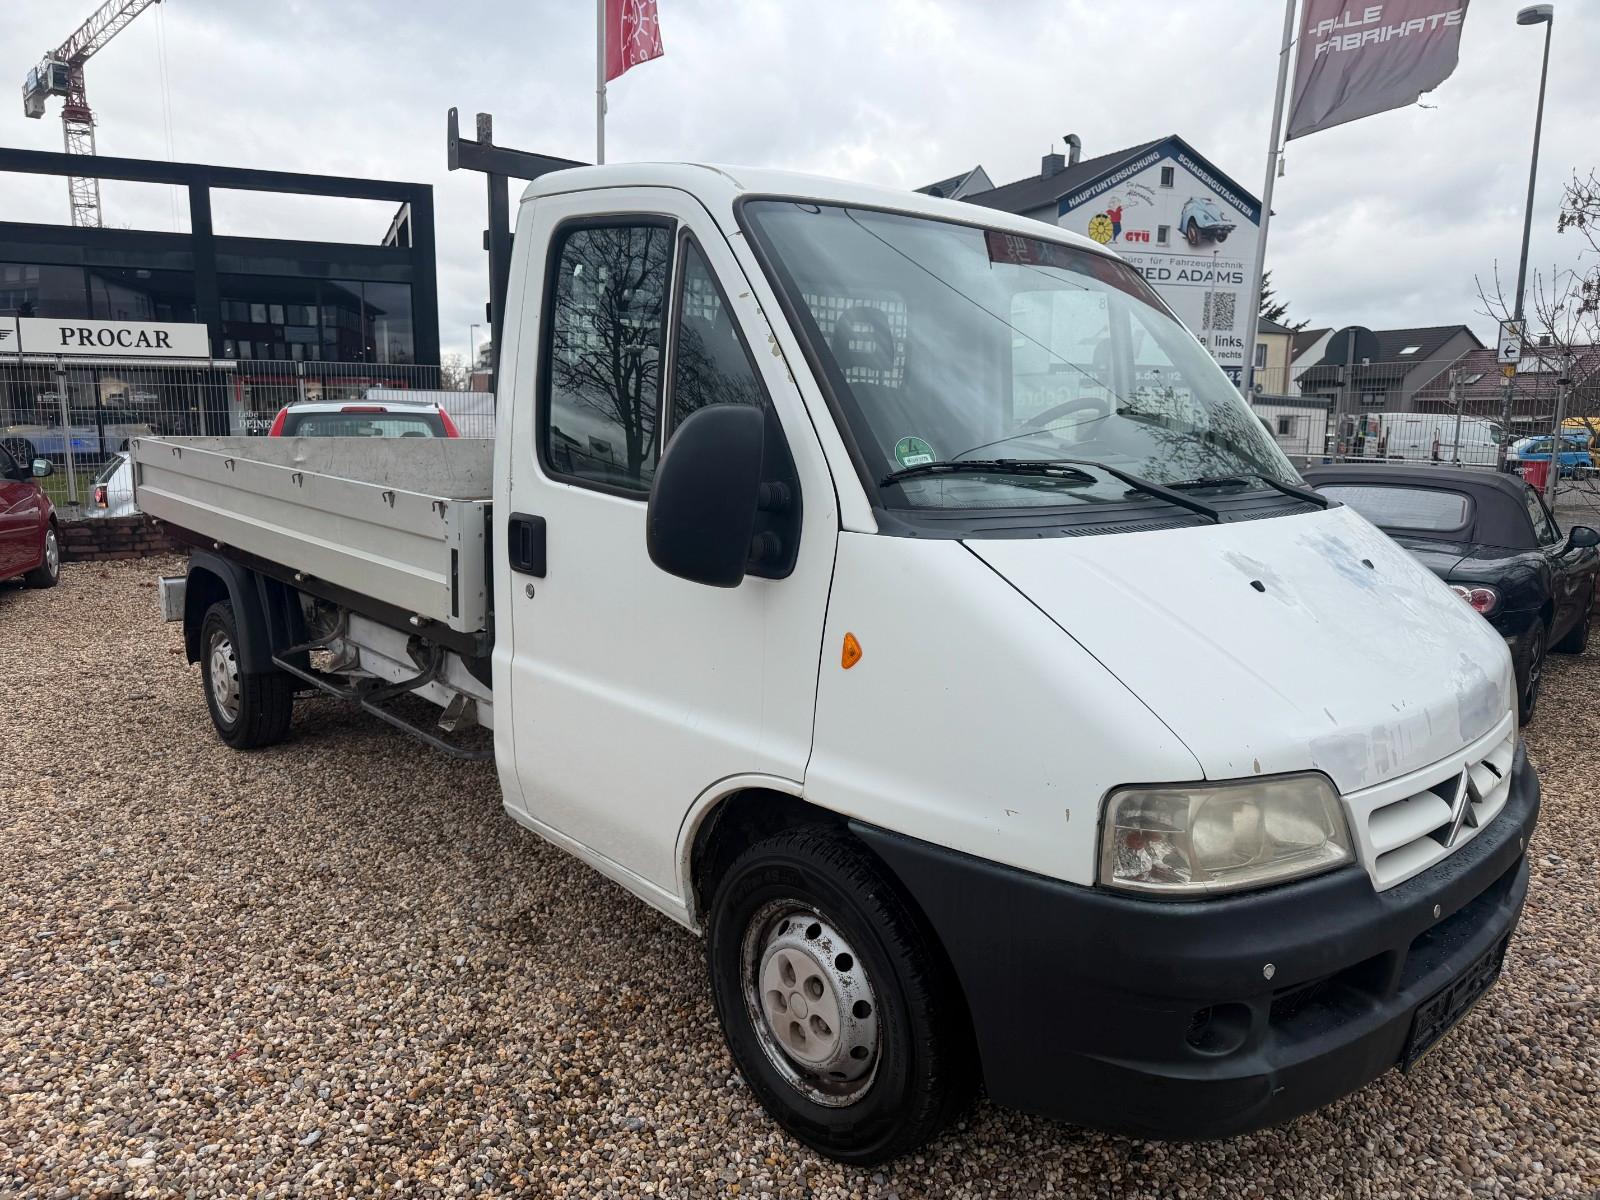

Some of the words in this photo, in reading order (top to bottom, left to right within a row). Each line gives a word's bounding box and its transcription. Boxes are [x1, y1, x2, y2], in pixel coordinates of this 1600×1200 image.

[1314, 8, 1463, 60] FABRIKATE
[1068, 151, 1160, 208] HAUPTUNTERSUCHUNG
[1178, 153, 1253, 217] SCHADENGUTACHTEN
[1125, 229, 1150, 243] GTÜ
[1150, 256, 1162, 265] für
[1169, 258, 1243, 270] Fahrzeugtechnik
[1177, 269, 1244, 284] ADAMS
[59, 327, 172, 348] PROCAR
[1215, 335, 1244, 349] links,
[1218, 351, 1242, 359] rechts
